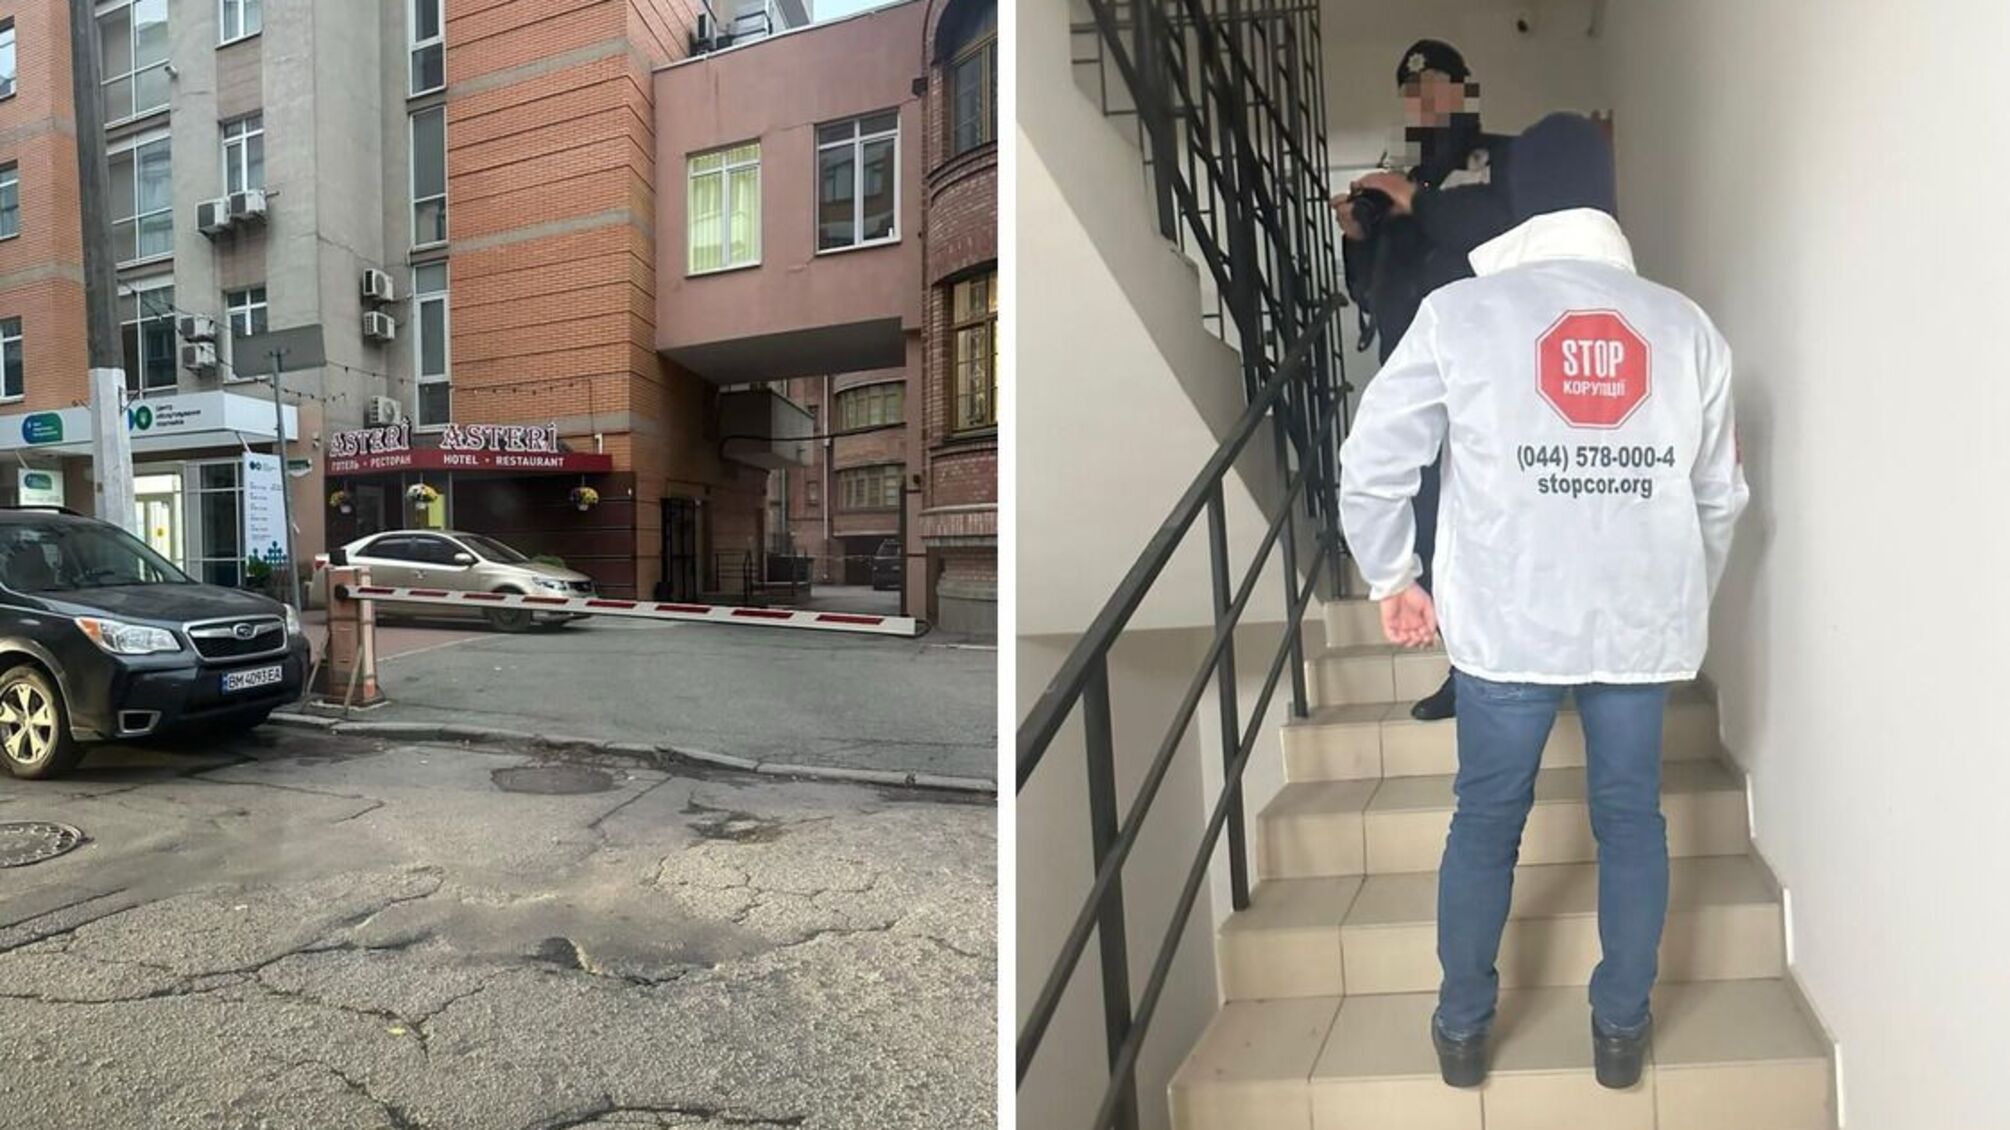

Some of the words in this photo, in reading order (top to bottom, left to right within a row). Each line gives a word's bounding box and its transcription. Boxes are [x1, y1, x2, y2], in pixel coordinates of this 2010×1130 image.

[1561, 339, 1625, 378] STOP
[370, 454, 412, 468] РЕСТОРАН
[443, 454, 479, 465] HOTEL
[495, 456, 565, 467] RESTAURANT
[1517, 444, 1569, 472] (044)
[1576, 446, 1675, 468] 578-000-4
[1538, 474, 1653, 499] stopcor.org
